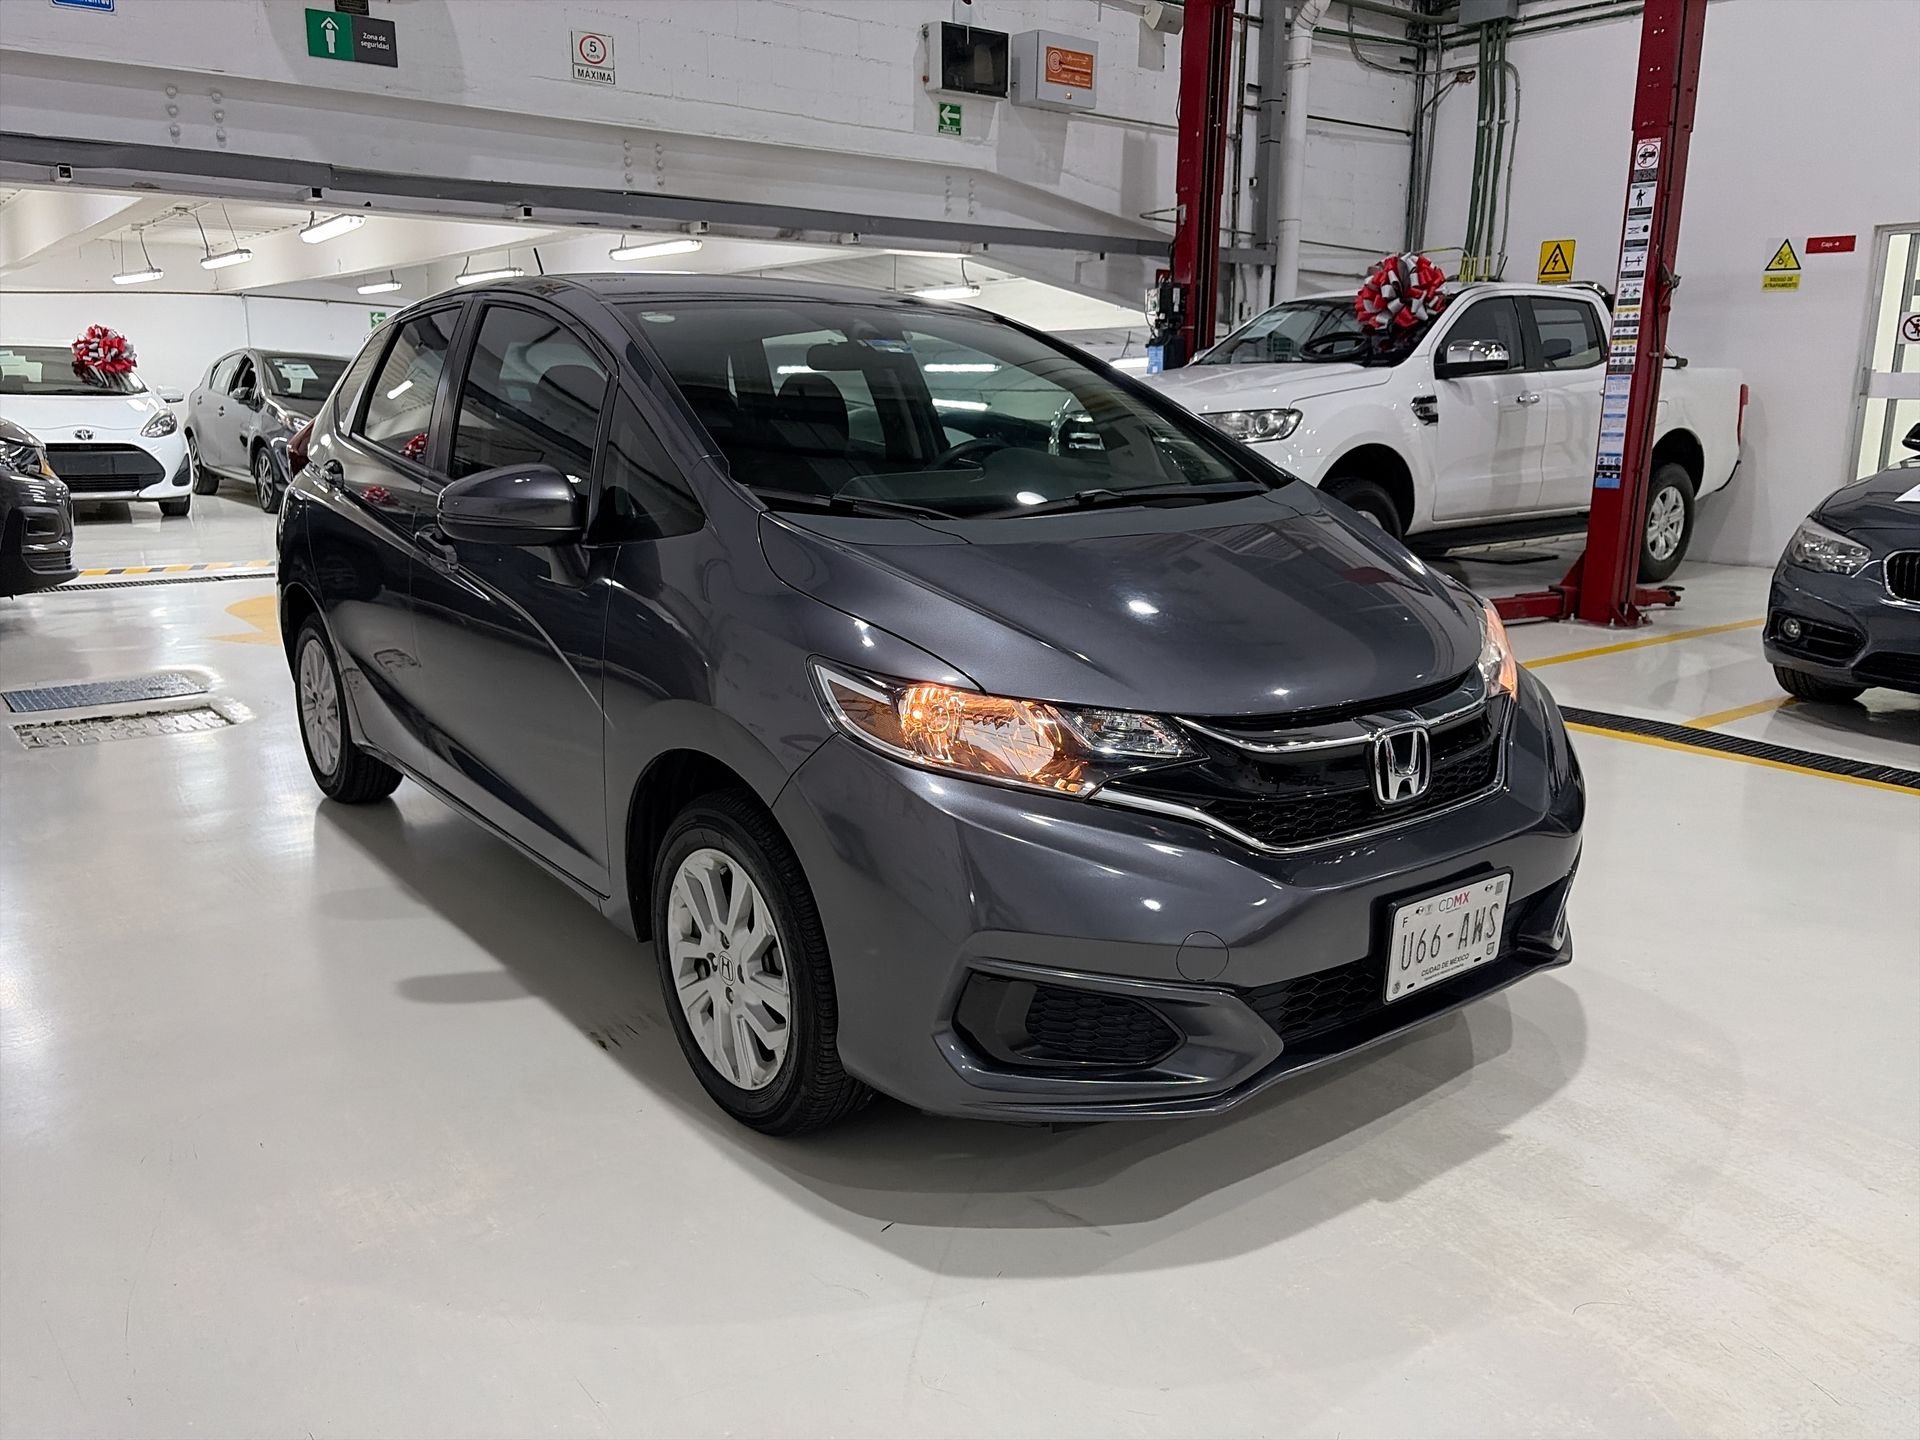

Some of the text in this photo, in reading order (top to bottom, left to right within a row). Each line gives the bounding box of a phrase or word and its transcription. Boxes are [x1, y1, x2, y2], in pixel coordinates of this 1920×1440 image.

[362, 32, 378, 41] Zona
[361, 41, 390, 50] seguridad
[590, 41, 597, 53] 5
[577, 68, 613, 83] MÁXIMA
[1438, 891, 1471, 912] CDMX
[1402, 916, 1409, 928] F
[1420, 963, 1441, 977] CIUDAD
[1441, 960, 1450, 968] DE
